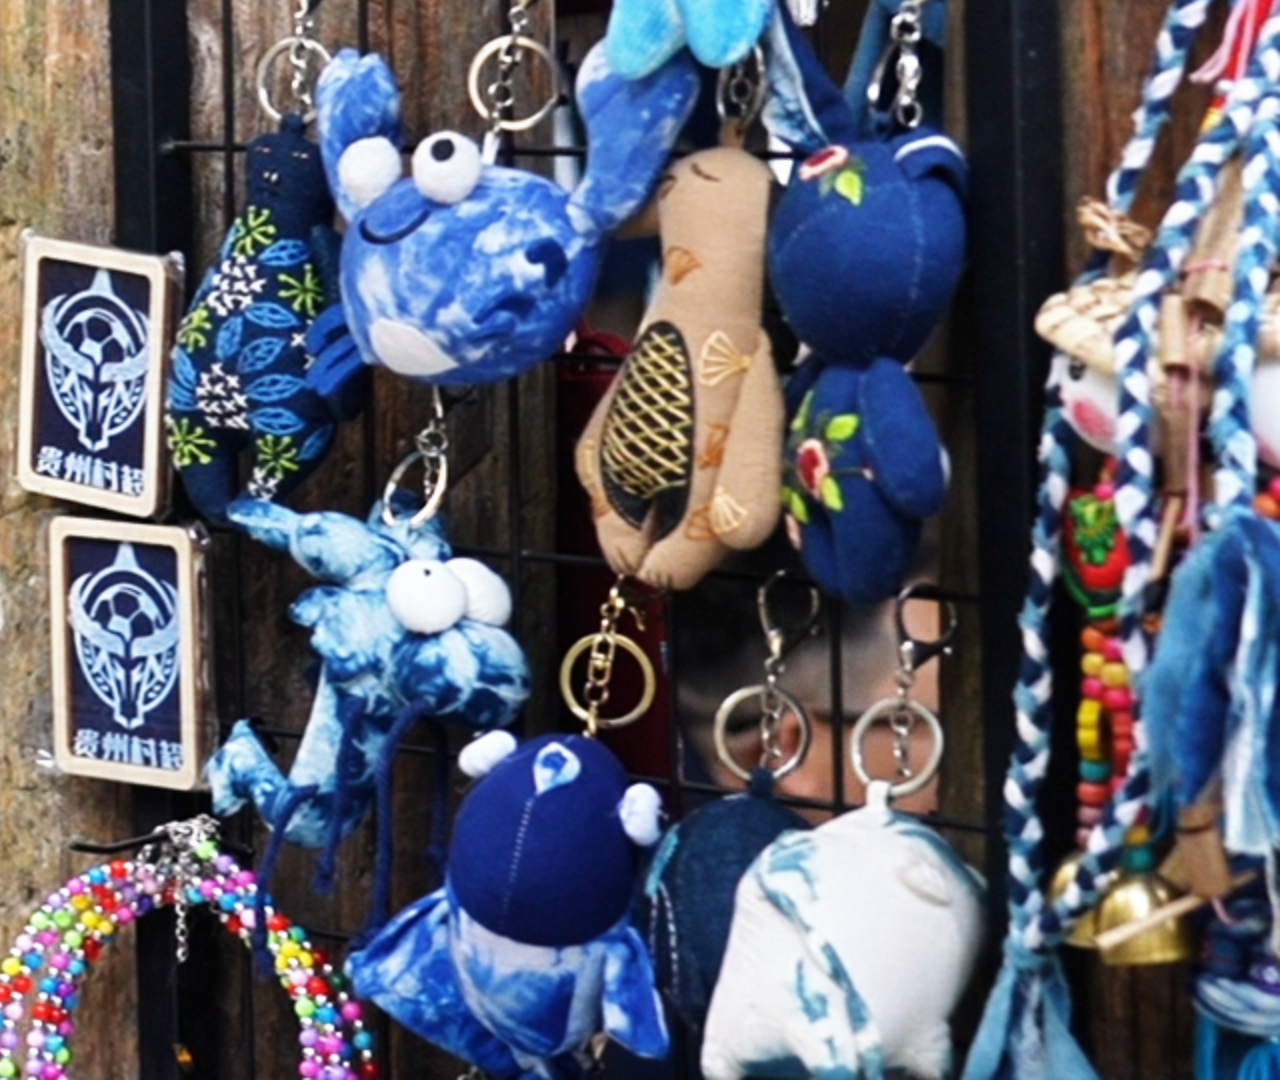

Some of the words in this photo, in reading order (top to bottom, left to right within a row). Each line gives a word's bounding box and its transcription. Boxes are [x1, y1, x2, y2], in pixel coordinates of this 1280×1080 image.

[36, 445, 145, 497] 贵州村超
[74, 728, 184, 772] 贵州村超
